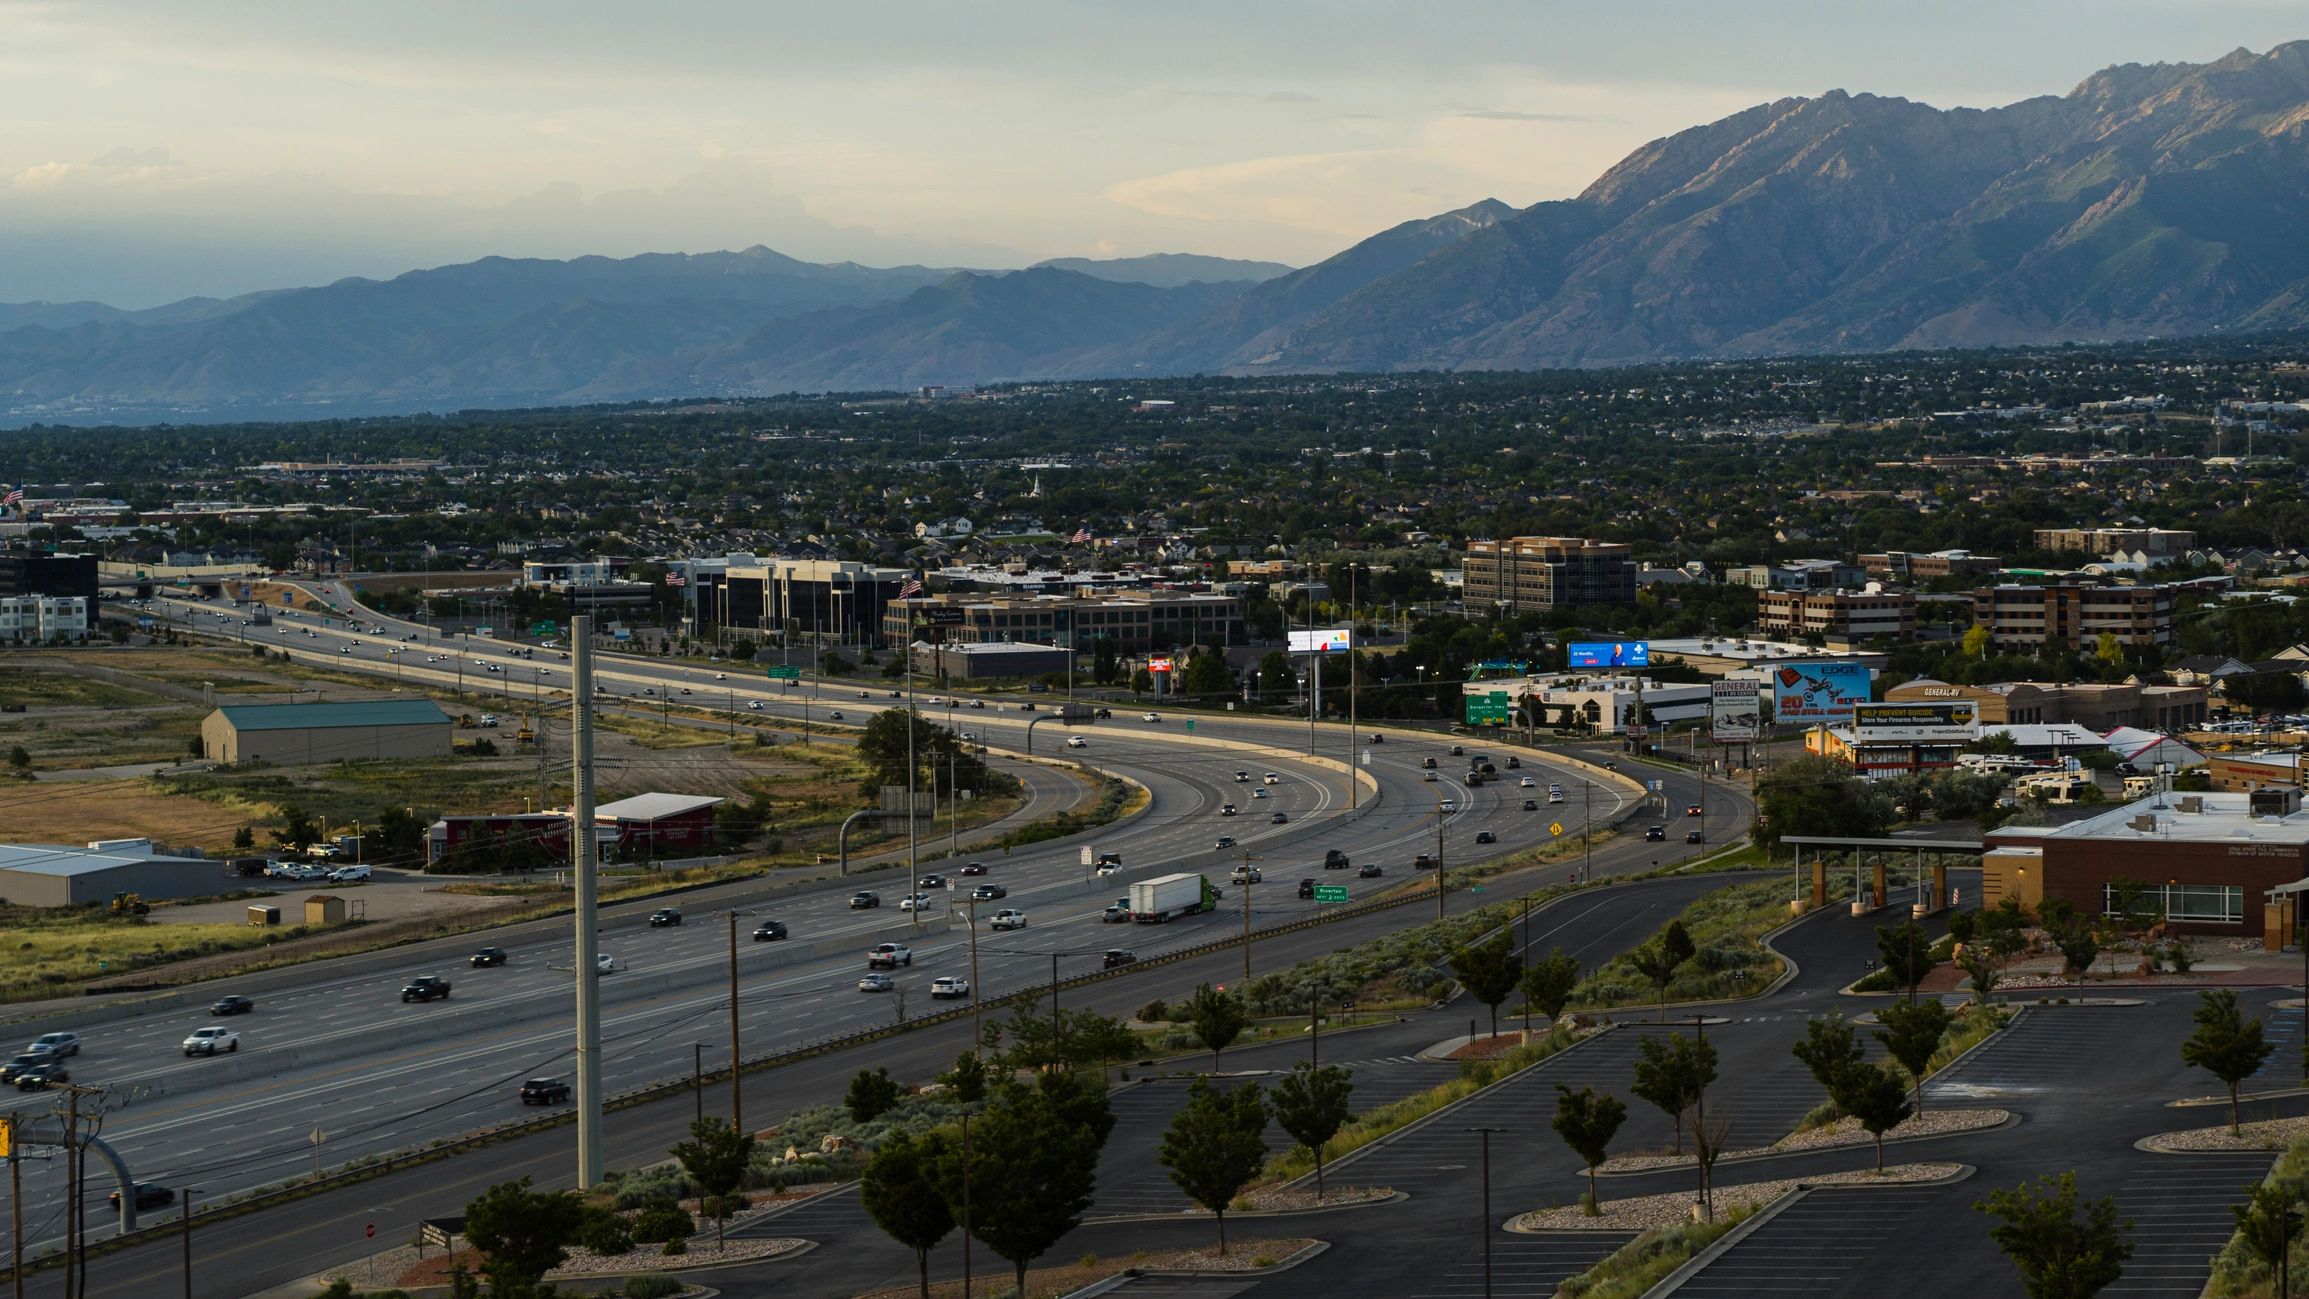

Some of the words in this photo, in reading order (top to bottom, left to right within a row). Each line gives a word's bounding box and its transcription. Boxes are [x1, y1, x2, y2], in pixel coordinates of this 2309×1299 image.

[1821, 666, 1858, 674] EDGE
[1714, 682, 1758, 690] GENERAL
[1781, 695, 1803, 708] 20
[1861, 709, 1877, 717] HELP
